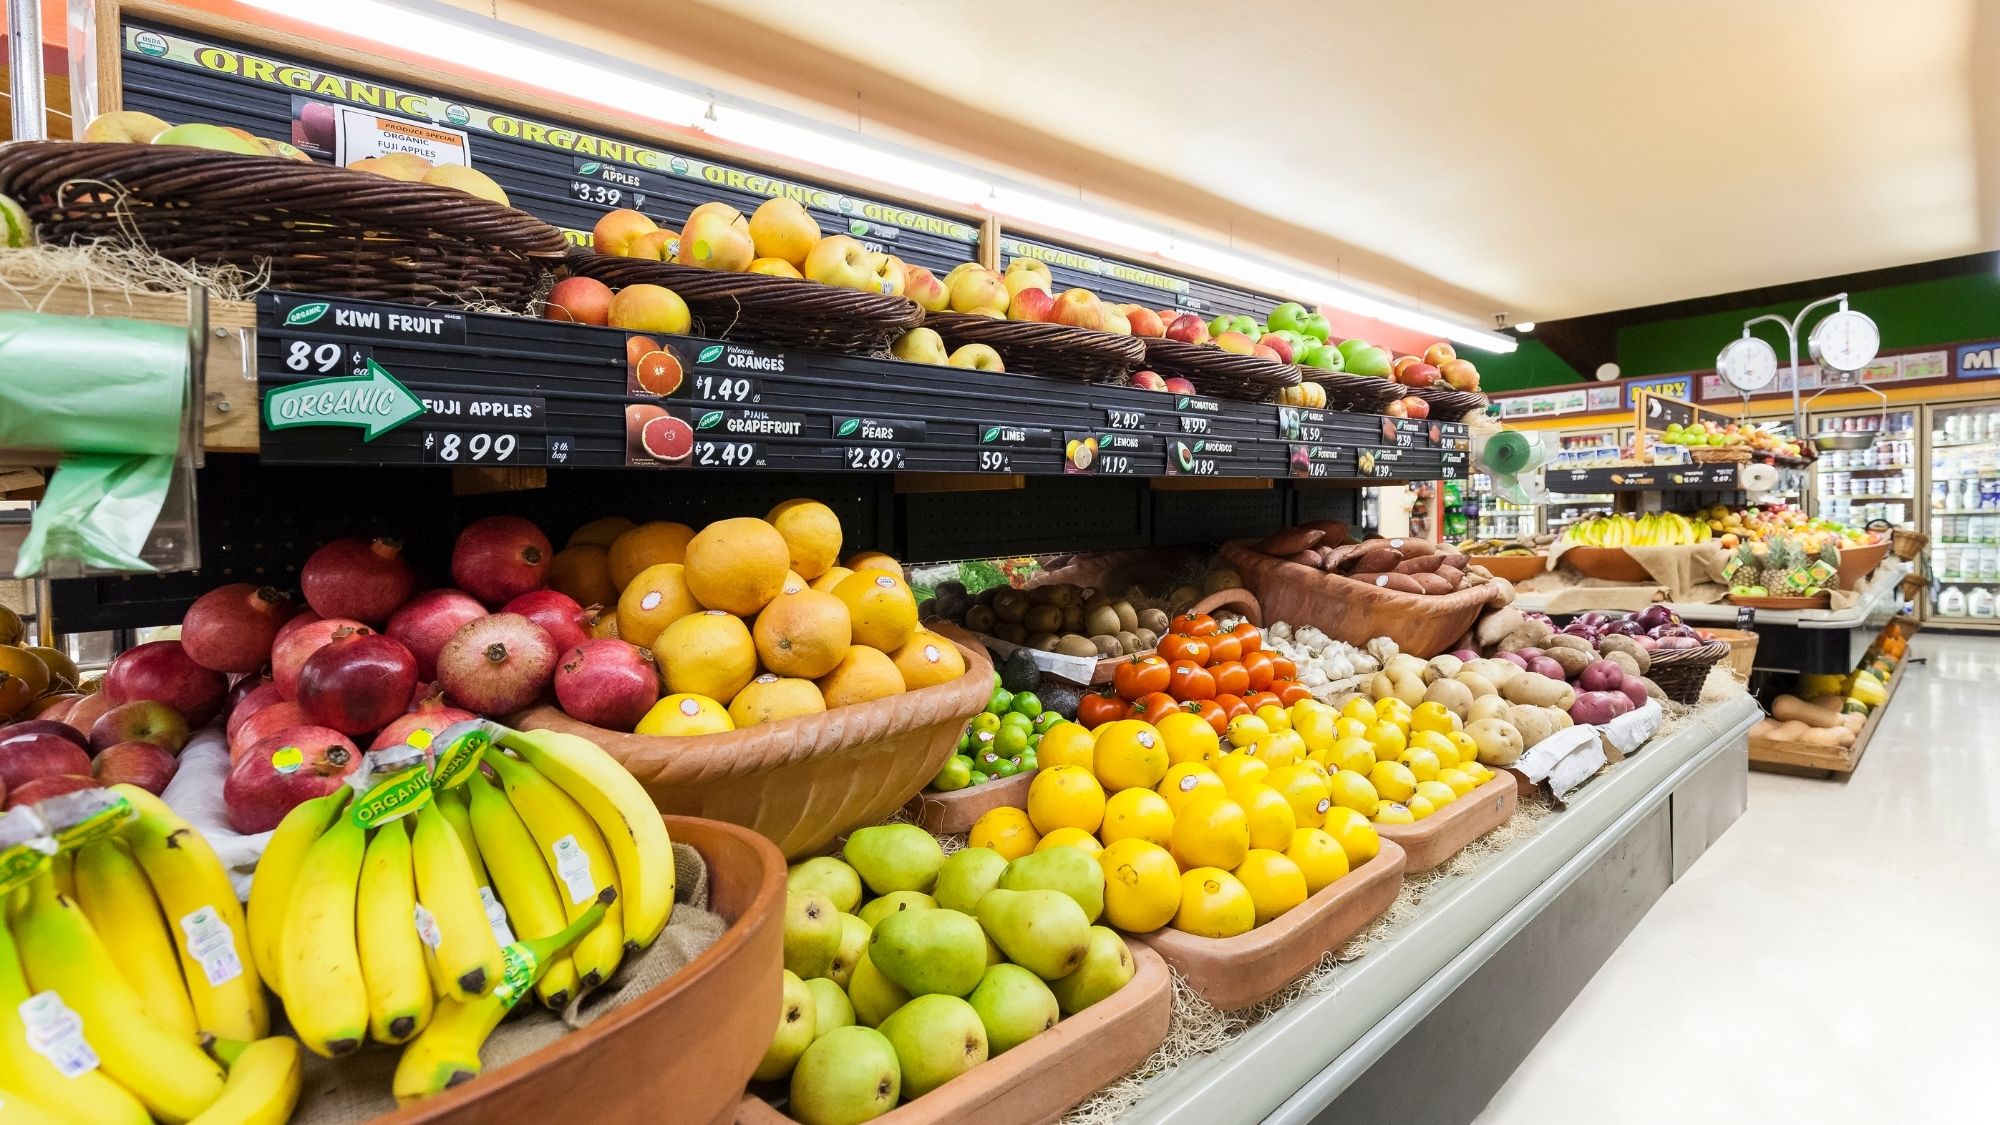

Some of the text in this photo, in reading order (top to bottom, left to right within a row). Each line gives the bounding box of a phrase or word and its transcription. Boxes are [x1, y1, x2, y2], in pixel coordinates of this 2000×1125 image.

[142, 36, 162, 46] USDA
[195, 47, 428, 117] ORGANIC
[383, 131, 429, 146] ORGANIC
[385, 123, 456, 142] PRODUCE SPECIAL
[378, 140, 398, 151] FUJI
[400, 145, 436, 158] APPLES
[488, 116, 657, 169] ORGANIC
[602, 170, 640, 187] APPLES
[702, 165, 830, 208] ORGANIC
[573, 181, 621, 206] $3.39
[863, 204, 963, 241] ORGANIC
[1017, 242, 1093, 271] ORGANIC
[1113, 265, 1176, 291] ORGANIC
[290, 305, 322, 322] ORGANIC
[335, 308, 444, 335] KIWI FRUIT
[286, 340, 342, 373] 89
[727, 345, 754, 355] Valencia
[727, 354, 785, 372] ORANGES
[696, 375, 750, 402] $1.49
[280, 386, 396, 420] ORGANIC
[423, 398, 533, 419] FUJI APPLES
[1190, 400, 1219, 411] TOMATOES
[743, 410, 770, 420] PINK
[1110, 411, 1139, 429] $2.49
[727, 418, 801, 435] GRAPEFRUIT
[862, 427, 894, 440] PEARS
[1002, 430, 1025, 442] LIMES
[1114, 437, 1139, 448] LEMONS
[551, 451, 567, 461] bag
[695, 441, 753, 466] $2.49
[1205, 442, 1232, 453] AVOCADOS
[848, 447, 894, 469] $2.89
[981, 451, 1003, 470] 59
[1102, 456, 1127, 473] $1.19
[358, 771, 432, 821] ORGANIC
